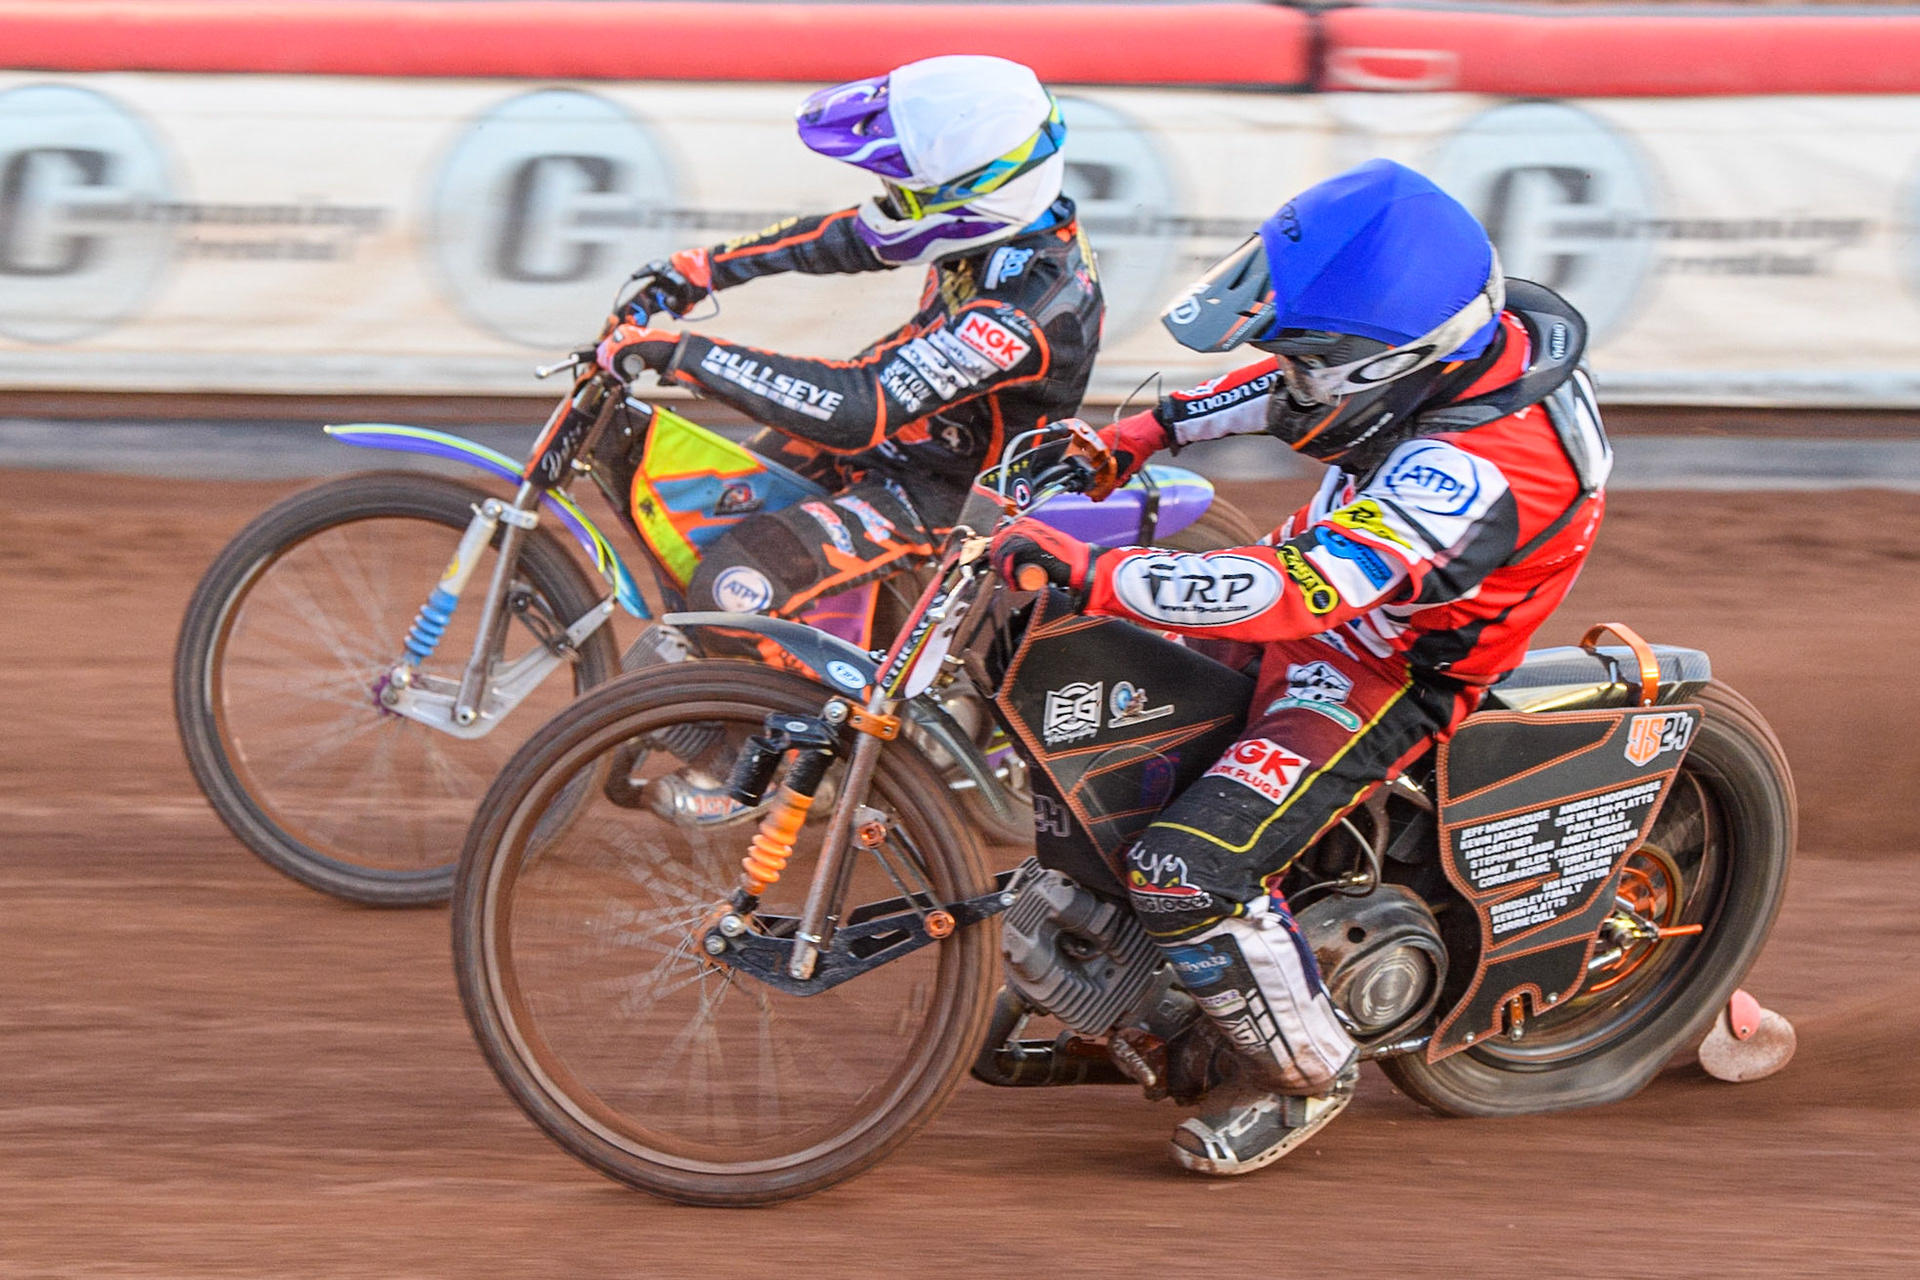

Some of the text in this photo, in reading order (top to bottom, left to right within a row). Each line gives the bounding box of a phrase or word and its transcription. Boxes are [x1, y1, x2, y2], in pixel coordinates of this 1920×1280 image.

[965, 316, 1024, 362] NGK
[705, 345, 844, 413] BULLSEYE
[879, 367, 922, 413] SKIPS
[1236, 768, 1282, 799] PLUGS
[1554, 793, 1655, 827] SUE WALSH-PLATTS
[1559, 780, 1661, 815] ANDREA MOORHOUSE
[1461, 809, 1551, 840] JEFF MOORHOUSE
[1566, 811, 1625, 834] PAUL MILLS
[1460, 823, 1539, 850] KEVIN JACKSON
[1554, 839, 1600, 859] FRANCES
[1561, 831, 1590, 846] ANDY
[1465, 847, 1484, 860] IAN
[1469, 847, 1528, 869] STEPHANIE
[1515, 852, 1549, 869] HELEN
[1557, 842, 1627, 868] TERRY SMITH
[1542, 867, 1610, 892] IAN WINSTON
[1544, 883, 1583, 901] FAMILY
[1527, 896, 1568, 914] PLATTS
[1531, 910, 1557, 924] CULL
